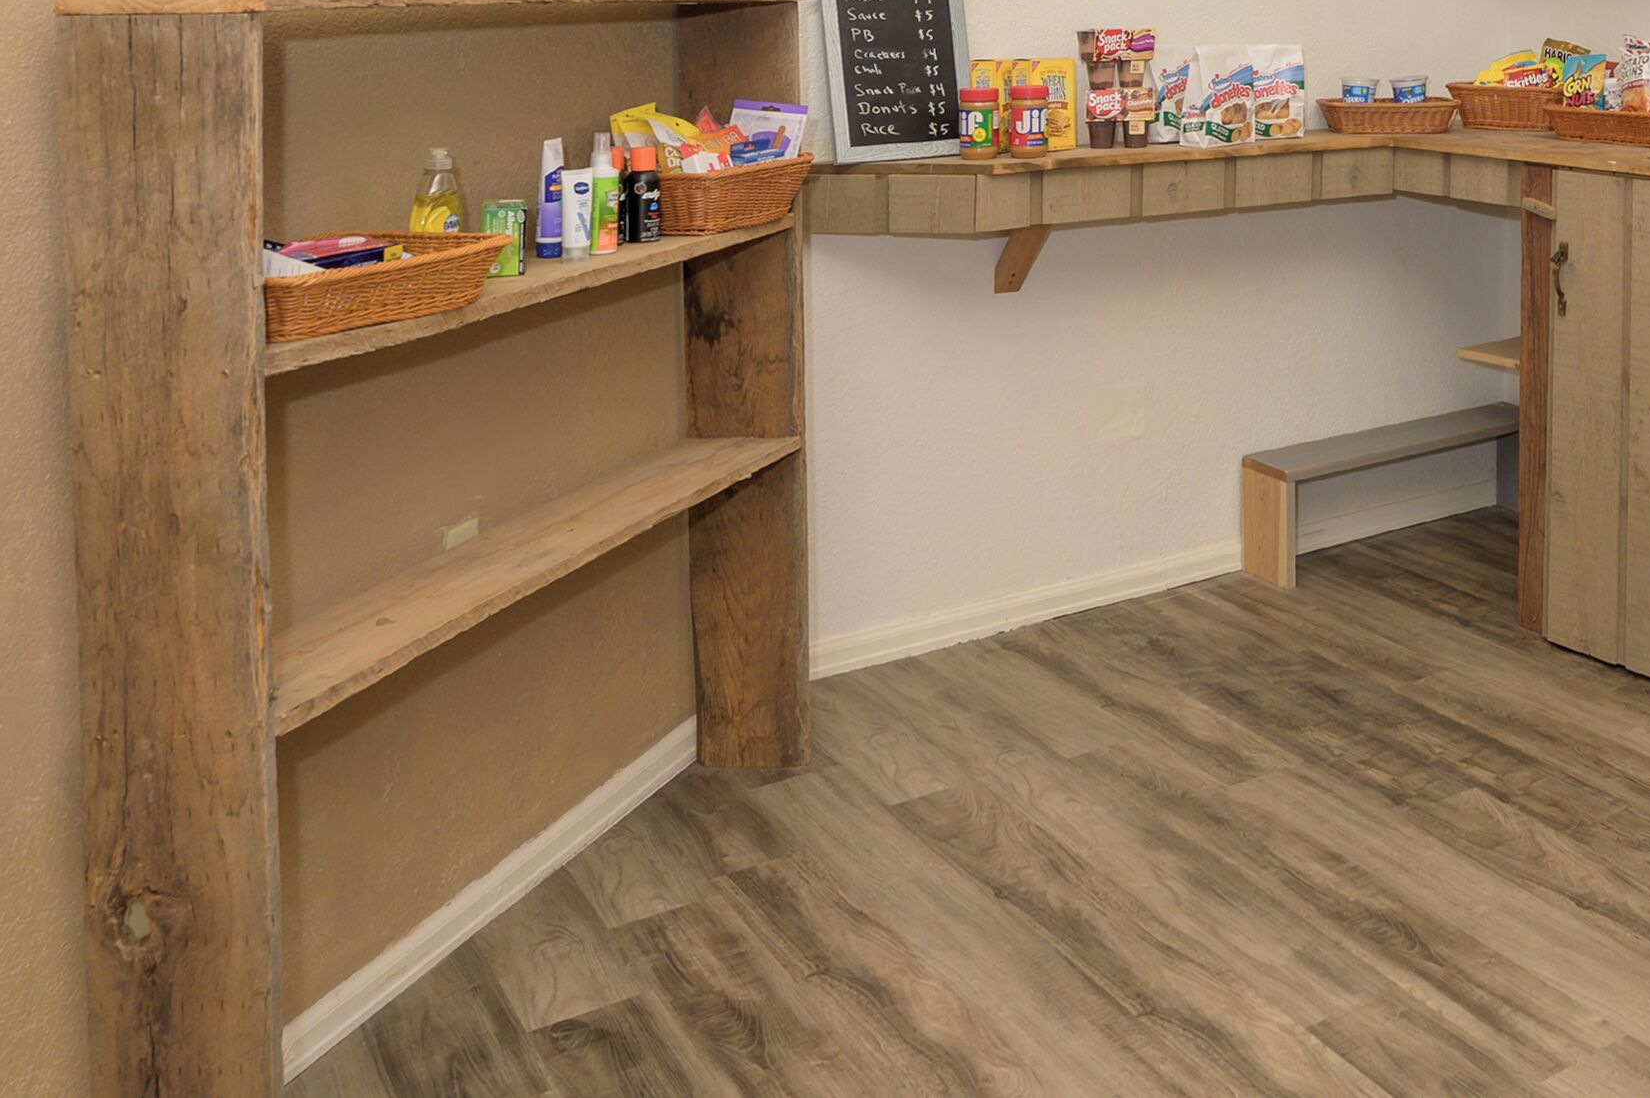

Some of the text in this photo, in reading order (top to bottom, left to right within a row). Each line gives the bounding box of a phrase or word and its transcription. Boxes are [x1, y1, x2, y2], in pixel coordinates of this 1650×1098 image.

[914, 10, 934, 22] $5
[851, 29, 934, 43] PB $5
[1098, 34, 1127, 46] Snack
[1104, 42, 1127, 54] pack
[925, 65, 940, 77] $5
[1507, 73, 1548, 88] Skittles
[1564, 75, 1592, 97] CORN
[929, 84, 945, 97] $4
[1049, 87, 1066, 101] HINS
[1165, 78, 1188, 100] donet
[1088, 92, 1122, 107] Snack
[1211, 84, 1251, 109] donettes
[858, 102, 946, 116] Donuts $5
[1096, 101, 1121, 115] pack
[961, 111, 984, 136] if
[1016, 108, 1048, 134] Jif
[929, 123, 950, 137] $5
[505, 210, 514, 236] Allerg
